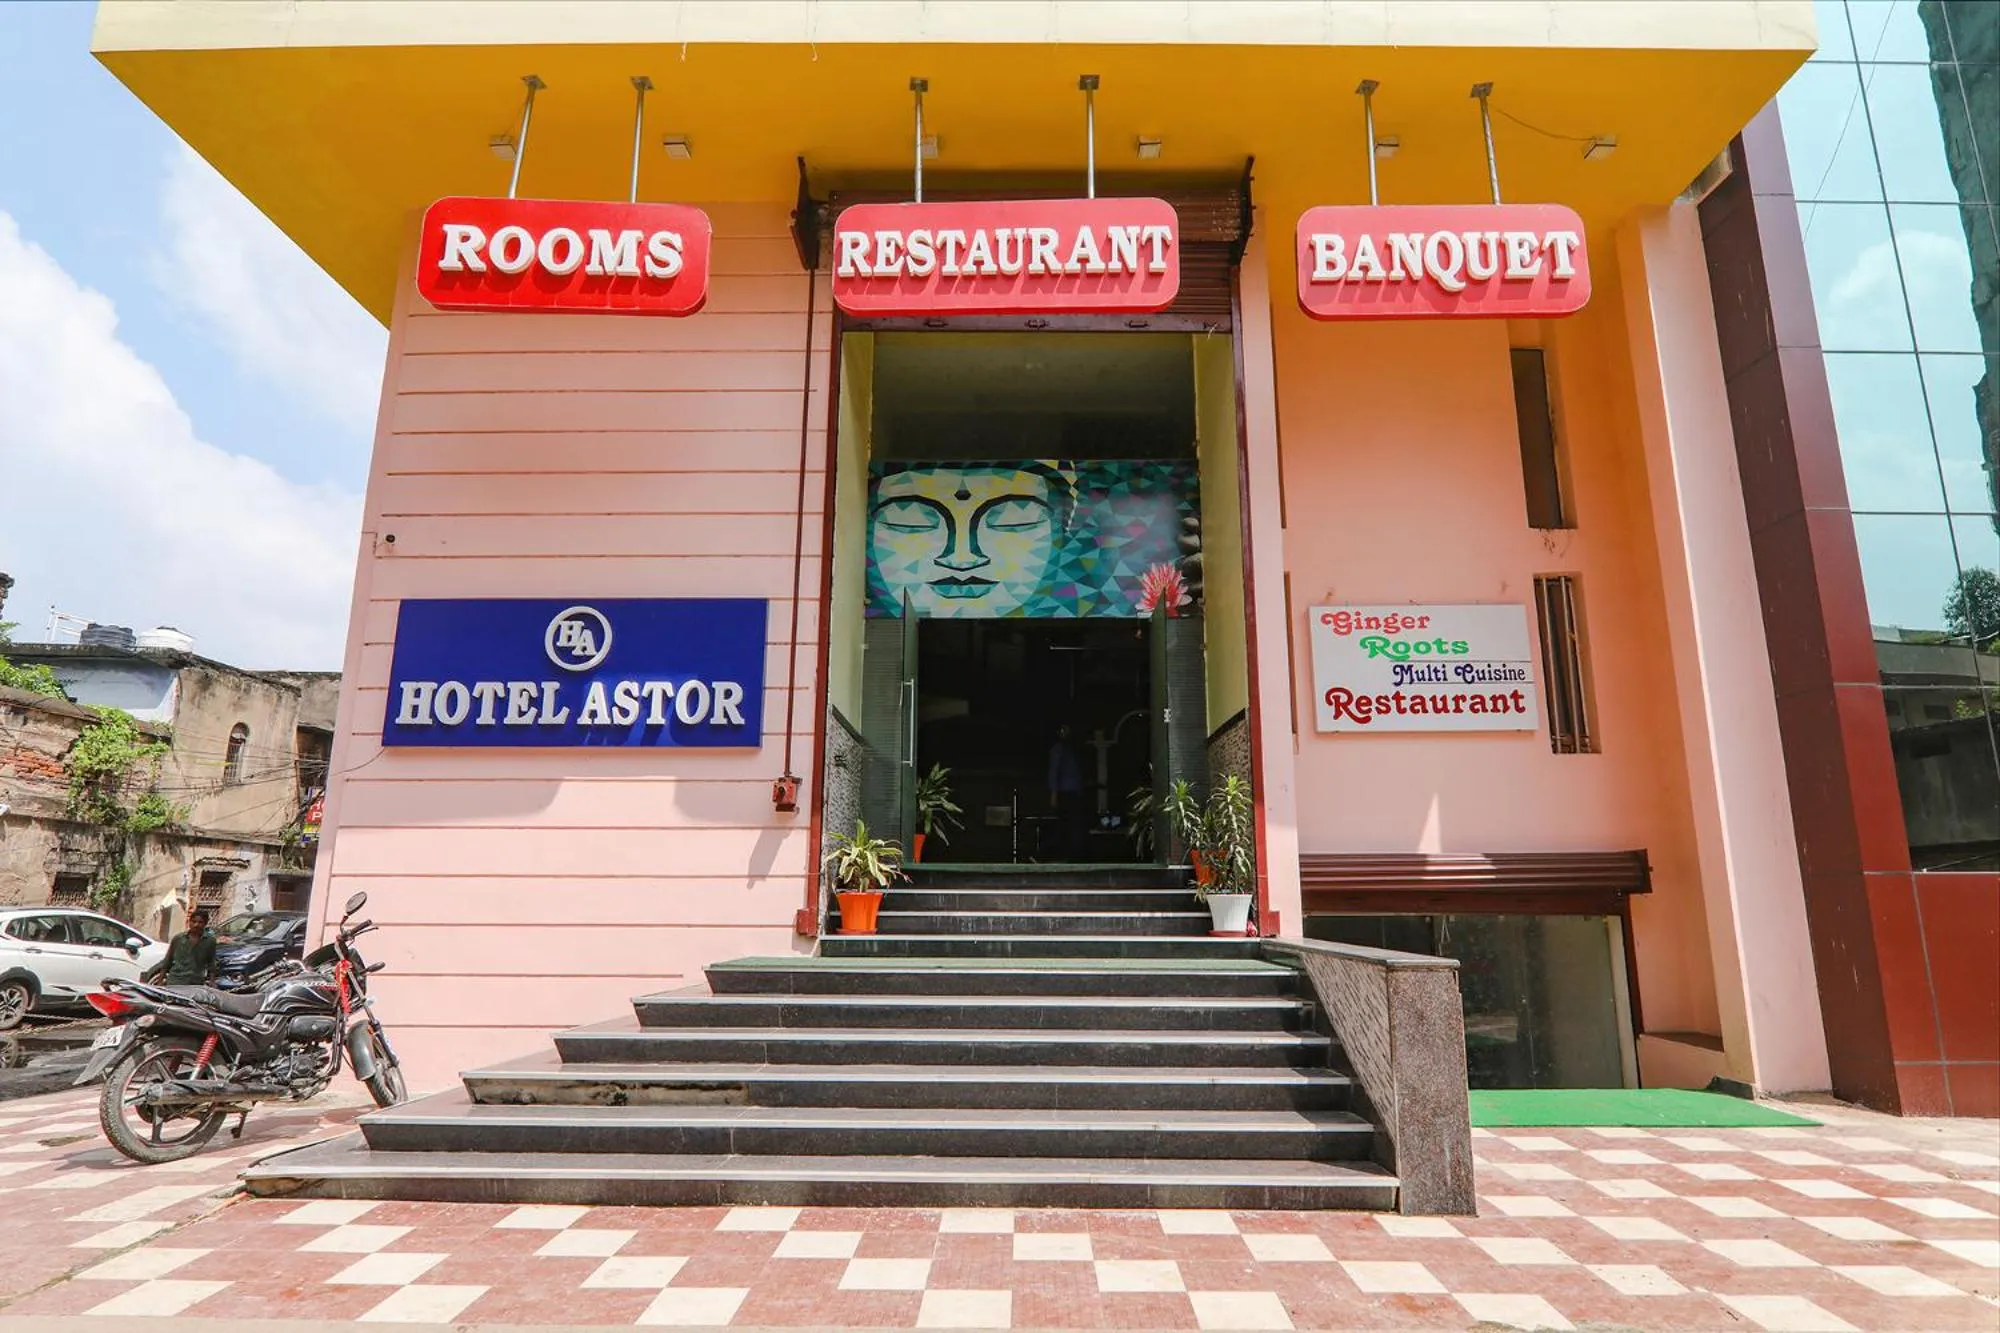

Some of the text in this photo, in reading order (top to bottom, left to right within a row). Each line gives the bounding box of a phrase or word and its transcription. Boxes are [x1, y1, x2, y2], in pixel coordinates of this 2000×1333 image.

[438, 224, 683, 279] ROOMS
[838, 225, 1173, 277] RESTAURANT
[1309, 230, 1580, 292] BANQUET
[556, 620, 598, 656] HA
[1321, 611, 1431, 636] Ginger
[1359, 636, 1470, 661] Roots
[1392, 664, 1526, 687] Multi Cuisine
[395, 680, 745, 726] HOTEL ASTOR
[1325, 687, 1527, 724] Restaurant
